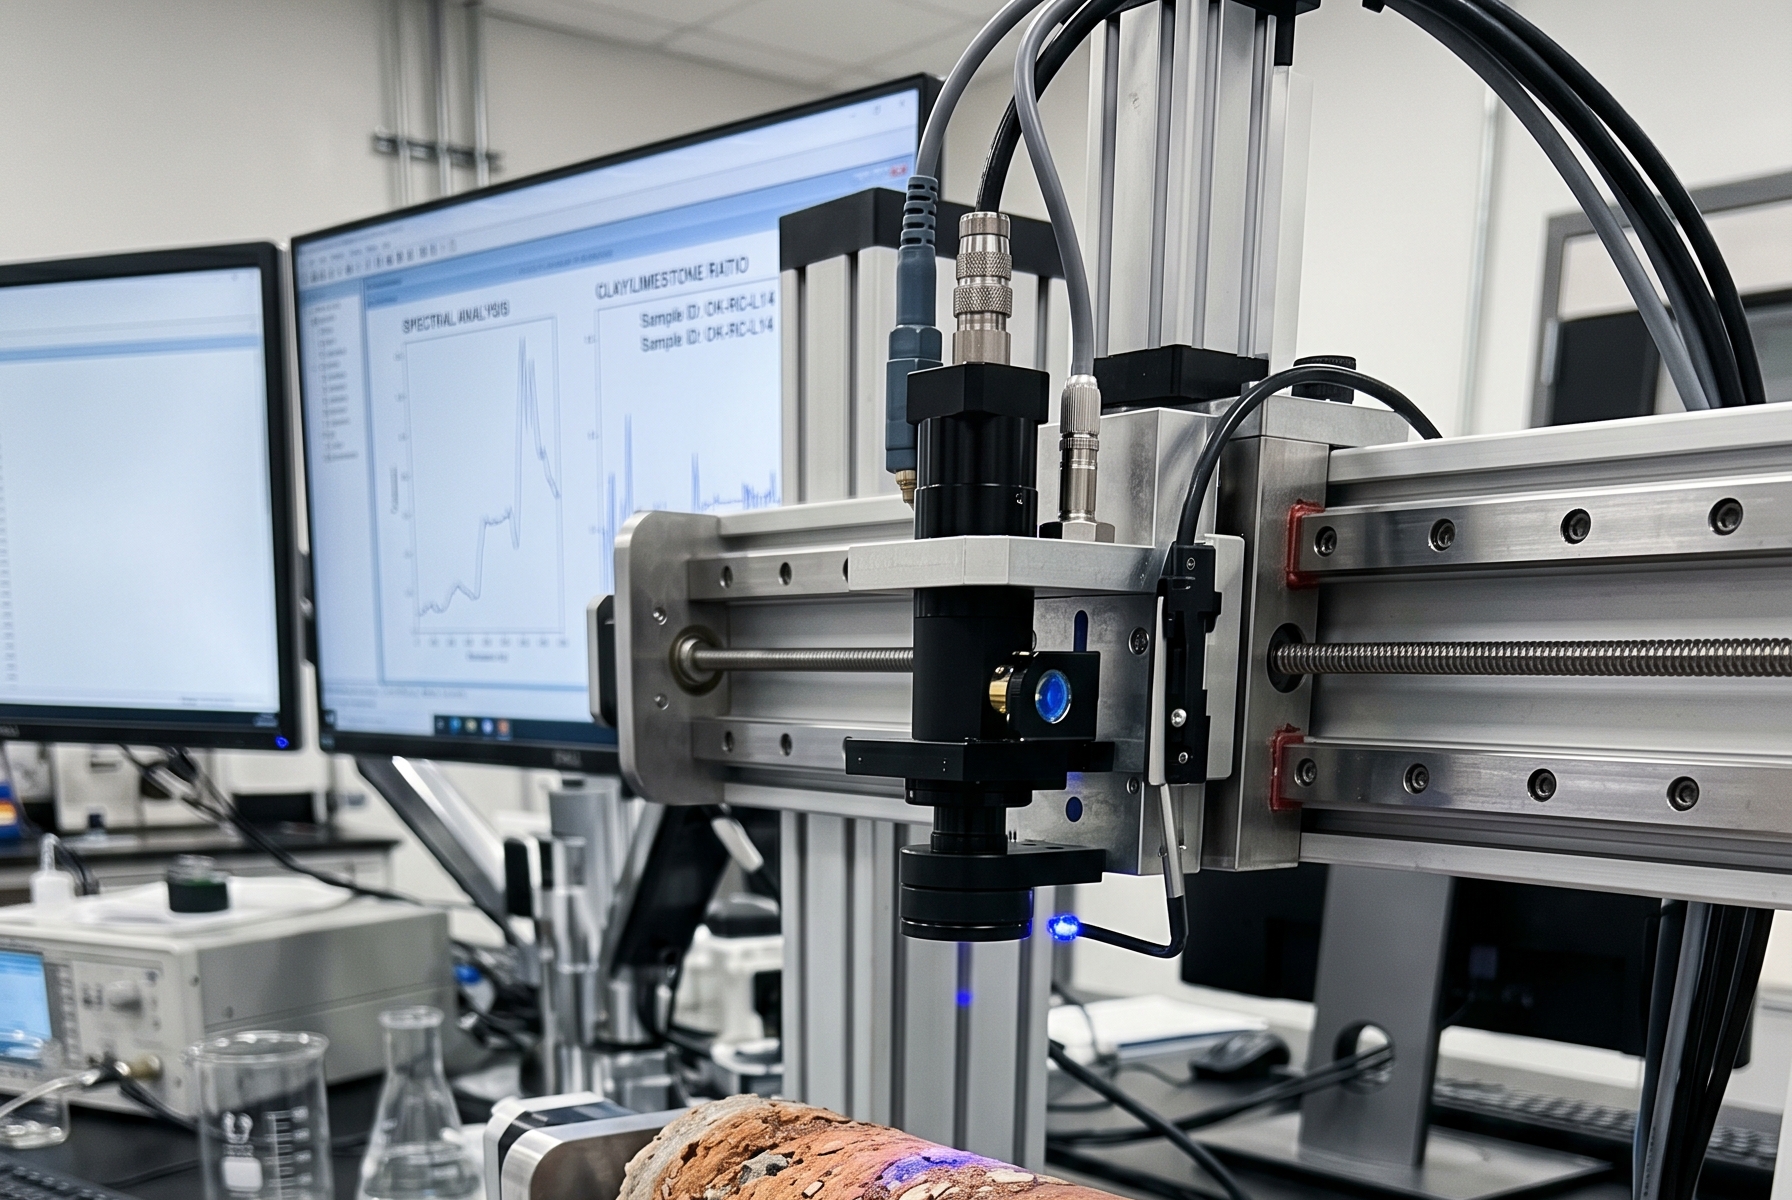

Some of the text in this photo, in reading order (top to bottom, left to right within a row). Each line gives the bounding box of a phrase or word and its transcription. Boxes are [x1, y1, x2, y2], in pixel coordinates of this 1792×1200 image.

[706, 256, 749, 278] RATIO
[402, 299, 510, 334] SPECTRAL ANALYSIS
[640, 308, 684, 329] Sample
[640, 333, 684, 352] Sample
